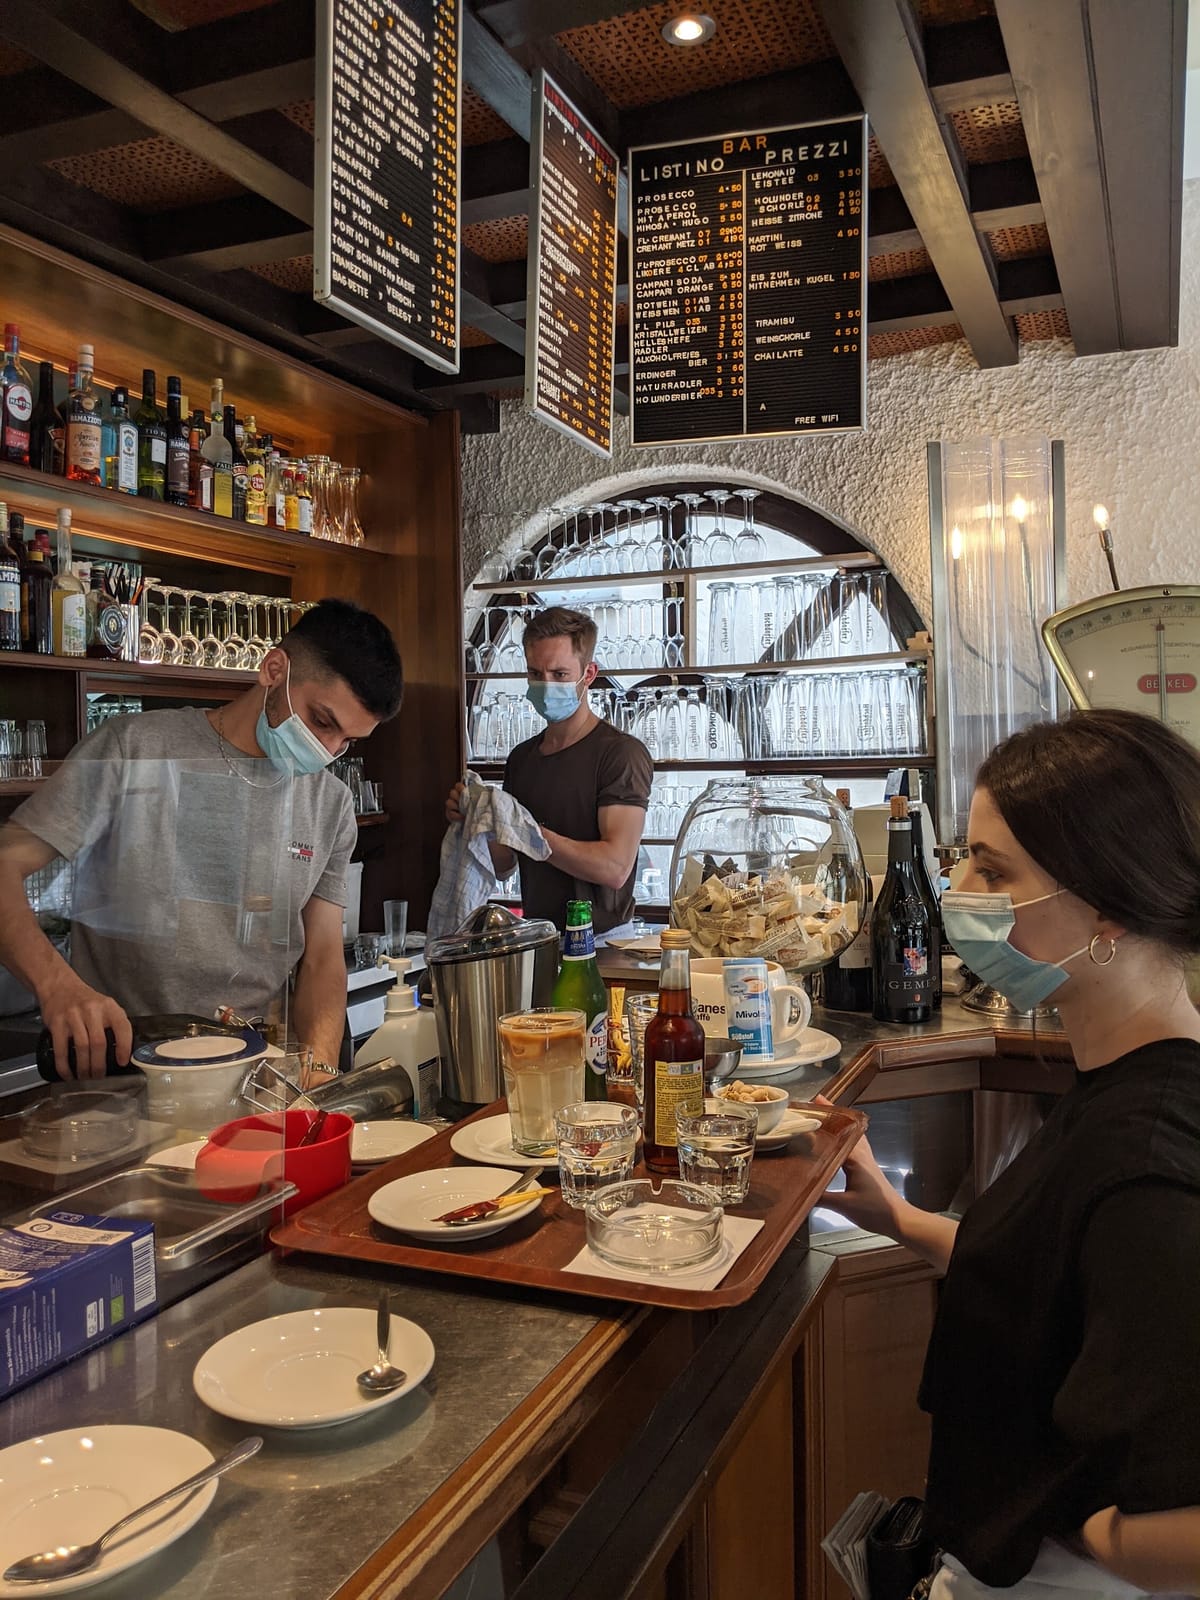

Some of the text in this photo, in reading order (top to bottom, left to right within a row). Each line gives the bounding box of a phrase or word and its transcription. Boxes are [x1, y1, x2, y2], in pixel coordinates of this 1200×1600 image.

[338, 0, 380, 50] ESPRESSO
[335, 16, 377, 65] ESPRESSO
[336, 90, 350, 112] TEE
[335, 107, 381, 154] AFFOGATO
[723, 134, 766, 154] BAR
[333, 142, 371, 182] EISKAFFEE
[640, 156, 724, 182] LISTINO
[765, 139, 847, 165] PREZZI
[751, 167, 795, 181] LEMONAID
[755, 176, 793, 189] EISTEE
[332, 177, 371, 216] CORTADO
[637, 189, 694, 204] PROSECCO
[637, 201, 696, 216] PROSECCO
[759, 200, 804, 213] SCHORLE
[636, 216, 708, 232] MIMOSA HUGO
[637, 210, 697, 224] MIT APEROL
[751, 215, 782, 227] HEISSE
[788, 210, 822, 222] ZITRONE
[334, 216, 369, 248] PORTION
[352, 209, 384, 241] PORTION
[651, 231, 691, 243] CREMANT
[748, 233, 782, 244] MARTINI
[636, 242, 672, 253] CREMANT
[676, 239, 695, 248] METZ
[750, 239, 802, 252] ROT WEISS
[636, 279, 673, 290] CAMPARI
[676, 275, 703, 285] SODA
[748, 273, 834, 290] MITNEHMEN KUGEL
[750, 270, 789, 282] EIS ZUM
[636, 287, 672, 298] CAMPARI
[677, 283, 713, 293] ORANGE
[636, 299, 677, 310] ROTWEIN
[655, 320, 675, 328] PILS
[755, 316, 794, 327] TIRAMISU
[634, 325, 707, 339] KRISTALLWEIZEN
[755, 331, 810, 344] WEINSCHORLE
[634, 345, 668, 355] RADLER
[635, 350, 699, 364] ALKOHOLFREIES
[688, 358, 707, 367] BIER
[635, 369, 676, 380] ERDINGER
[635, 379, 702, 392] NATURRADLER
[794, 413, 838, 424] FREE WIFI
[1146, 679, 1188, 689] BEKEL
